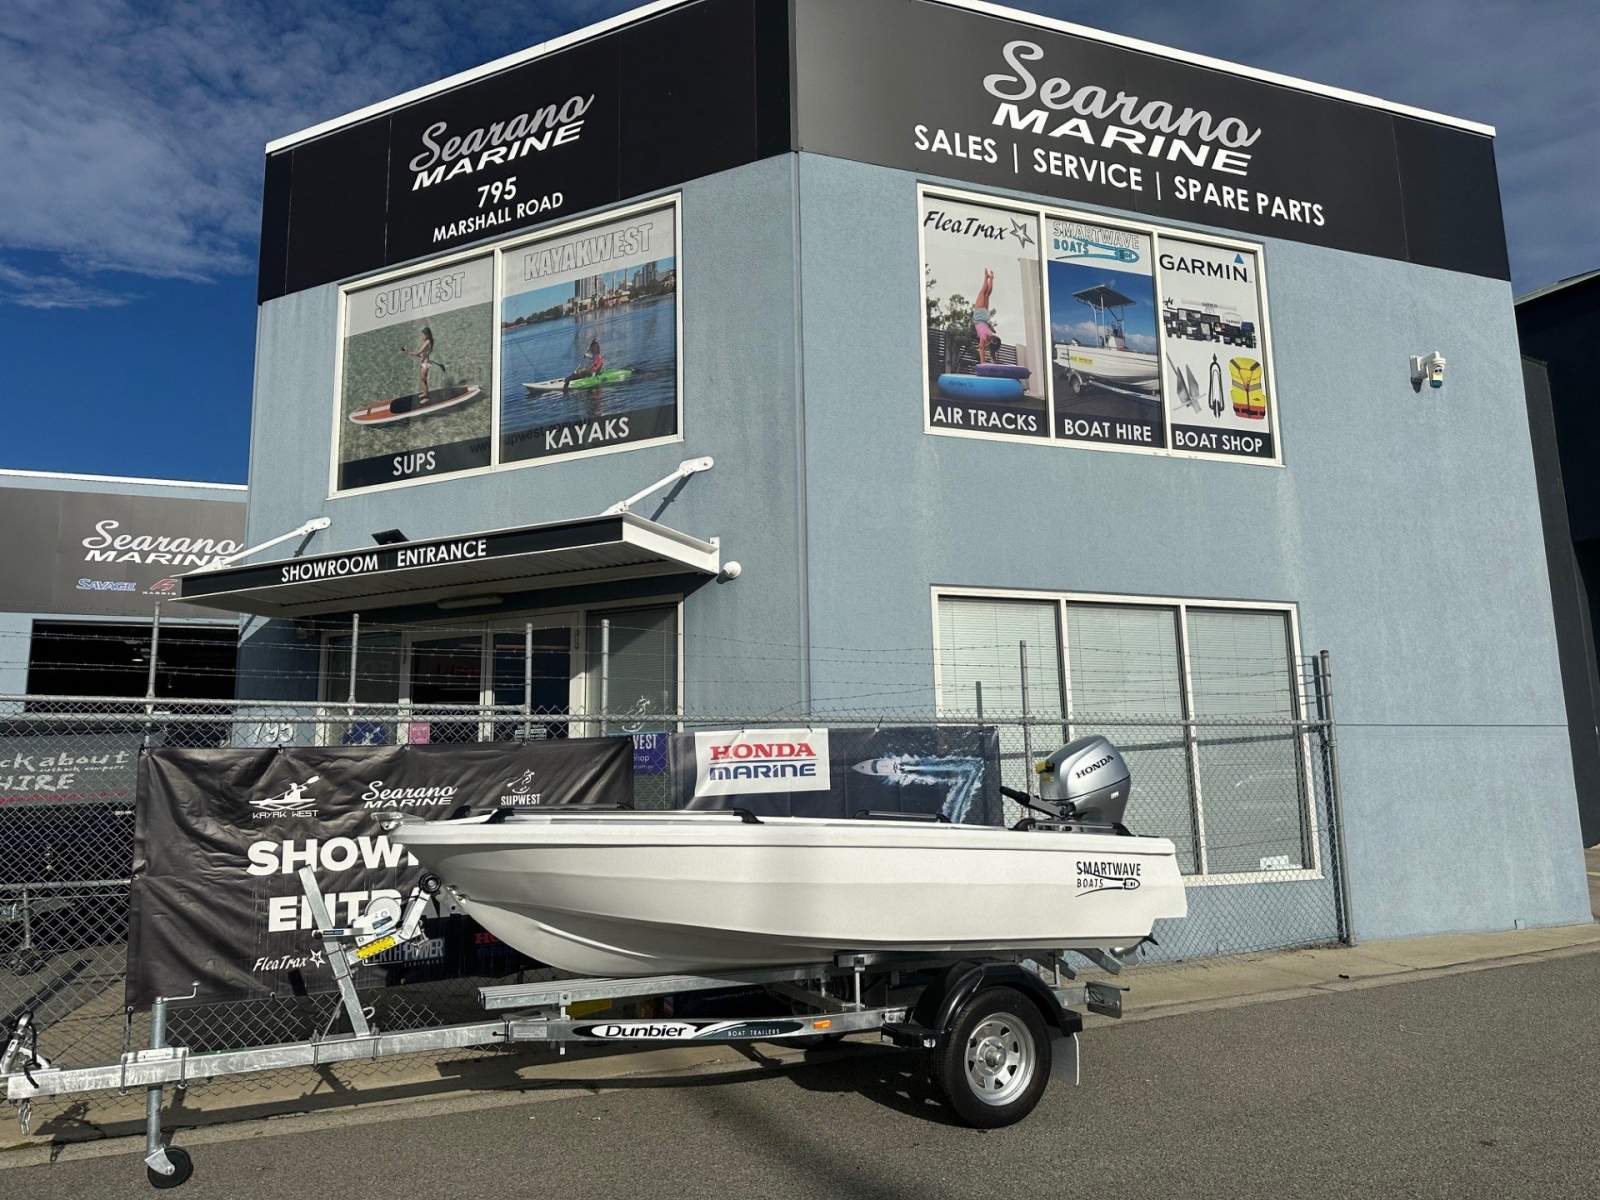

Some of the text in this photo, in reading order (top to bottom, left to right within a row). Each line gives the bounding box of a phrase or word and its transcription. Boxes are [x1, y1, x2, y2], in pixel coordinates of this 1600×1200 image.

[983, 40, 1261, 148] Searano
[409, 94, 595, 172] Searano
[992, 102, 1252, 176] MARINE
[412, 119, 585, 191] MARINE
[914, 125, 1325, 226] SALES SERVICE SPARE PARTS
[477, 176, 517, 208] 795
[433, 192, 563, 242] MARSHALL ROAD
[924, 211, 1008, 240] FleaTrax
[1053, 221, 1140, 249] SMARTWAVE
[1053, 239, 1088, 255] BOATS
[524, 223, 653, 281] KAYAKWEST
[1160, 254, 1248, 283] GARMIN
[375, 272, 465, 318] SUPWEST
[933, 406, 1037, 432] AIR TRACKS
[1064, 419, 1152, 442] BOAT HIRE
[545, 416, 630, 450] KAYAKS
[1175, 431, 1263, 453] BOAT SHOP
[393, 451, 435, 476] SUPS
[82, 520, 244, 554] Searano
[282, 540, 487, 582] SHOWROOM ENTRANCE
[711, 743, 816, 760] HONDA
[1076, 754, 1115, 779] HONDA
[361, 780, 458, 801] Searano
[363, 797, 454, 809] MARINE
[501, 793, 541, 806] SUPWEST
[252, 809, 319, 819] KAYAK WEST
[246, 835, 419, 876] SHOW
[1076, 861, 1141, 876] SMARTWAVE
[1077, 878, 1104, 888] BOATS
[253, 955, 307, 973] FleaTrax
[605, 1023, 687, 1038] Dunbier
[750, 1028, 780, 1036] TRAILERS
